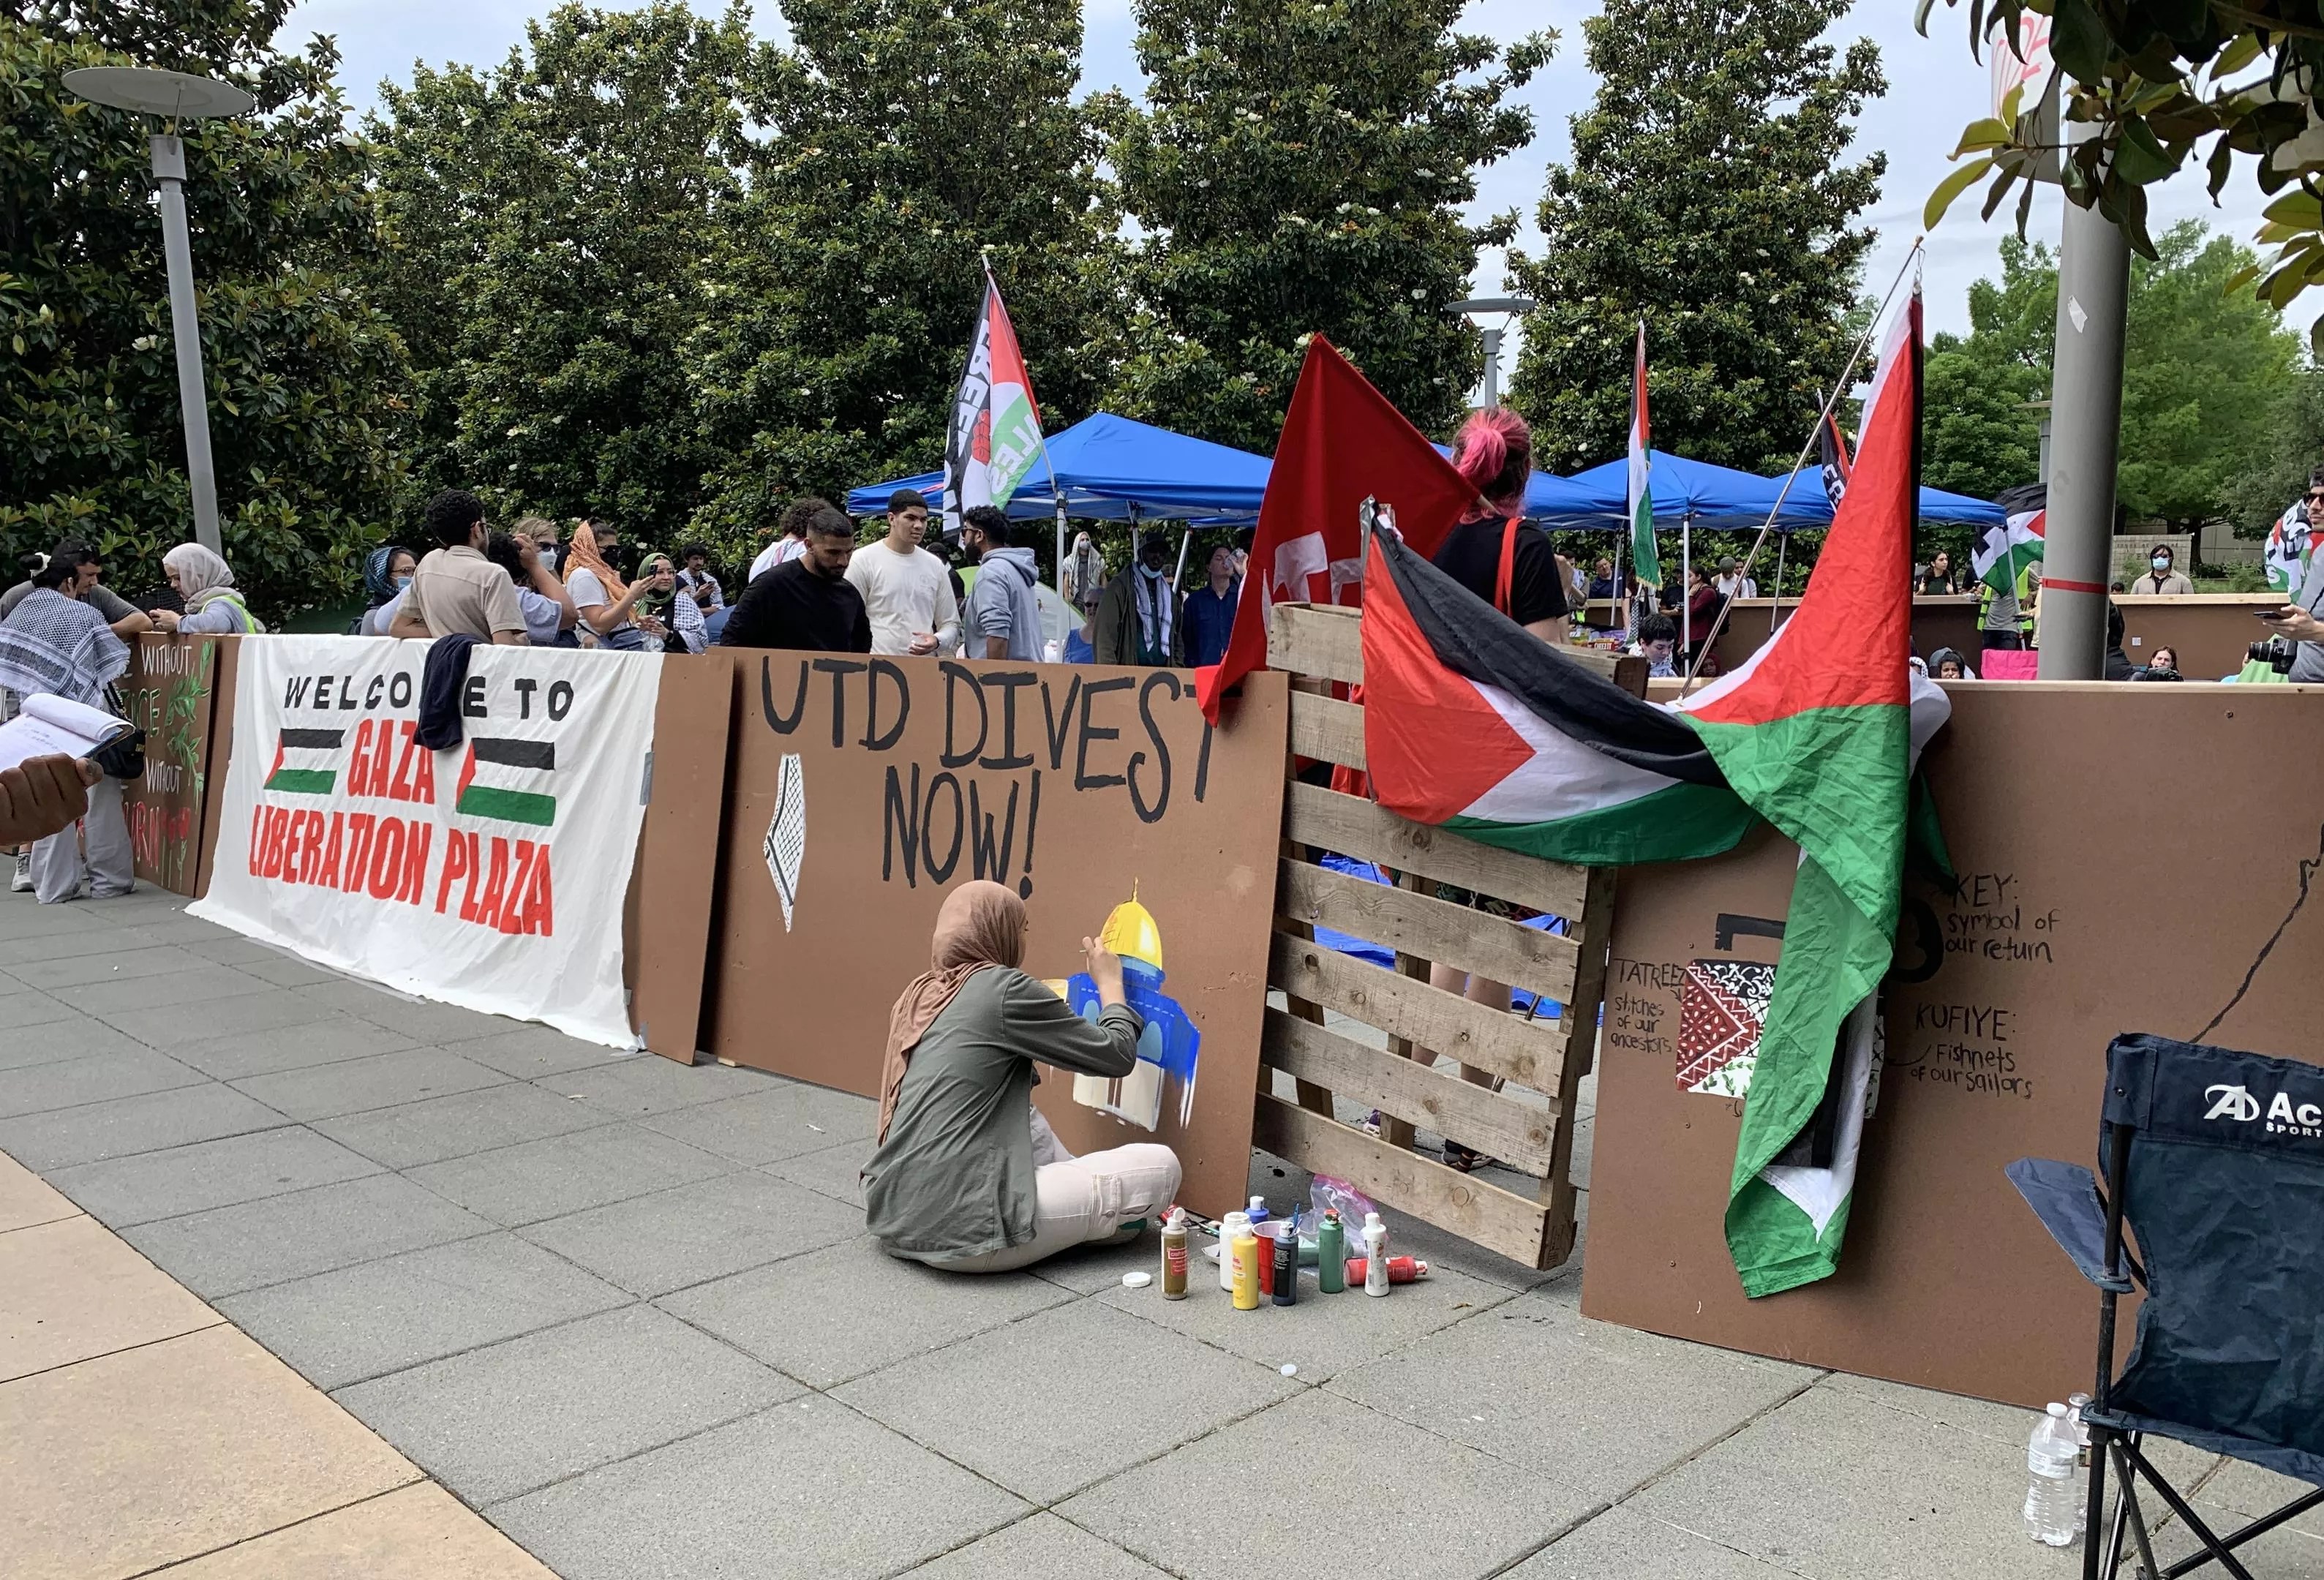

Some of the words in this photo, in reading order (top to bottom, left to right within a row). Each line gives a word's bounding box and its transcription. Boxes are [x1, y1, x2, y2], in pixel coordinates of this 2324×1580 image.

[141, 643, 192, 677] WITHOUT
[284, 672, 488, 718] WELCOE
[514, 678, 575, 722] TO
[762, 655, 910, 750] UTD
[939, 661, 1243, 823] DIVEST
[146, 757, 182, 794] WITHOUT
[347, 719, 435, 805] GAZA
[882, 762, 1041, 900] NOW!
[249, 804, 432, 906] LIBERATION
[435, 827, 553, 937] PLAZA
[1953, 873, 2017, 908] KEY:
[1947, 904, 2020, 935] symbol
[2035, 908, 2061, 933] of
[1945, 937, 1977, 953] our
[1984, 936, 2053, 963] return
[1615, 992, 1665, 1016] stitches
[1617, 1015, 1631, 1028] of
[1634, 1018, 1661, 1034] our
[1916, 1003, 2016, 1042] KUFIYE:
[1610, 1032, 1672, 1055] ancestors
[1936, 1042, 2016, 1074] Fishnets
[1930, 1068, 1963, 1086] our
